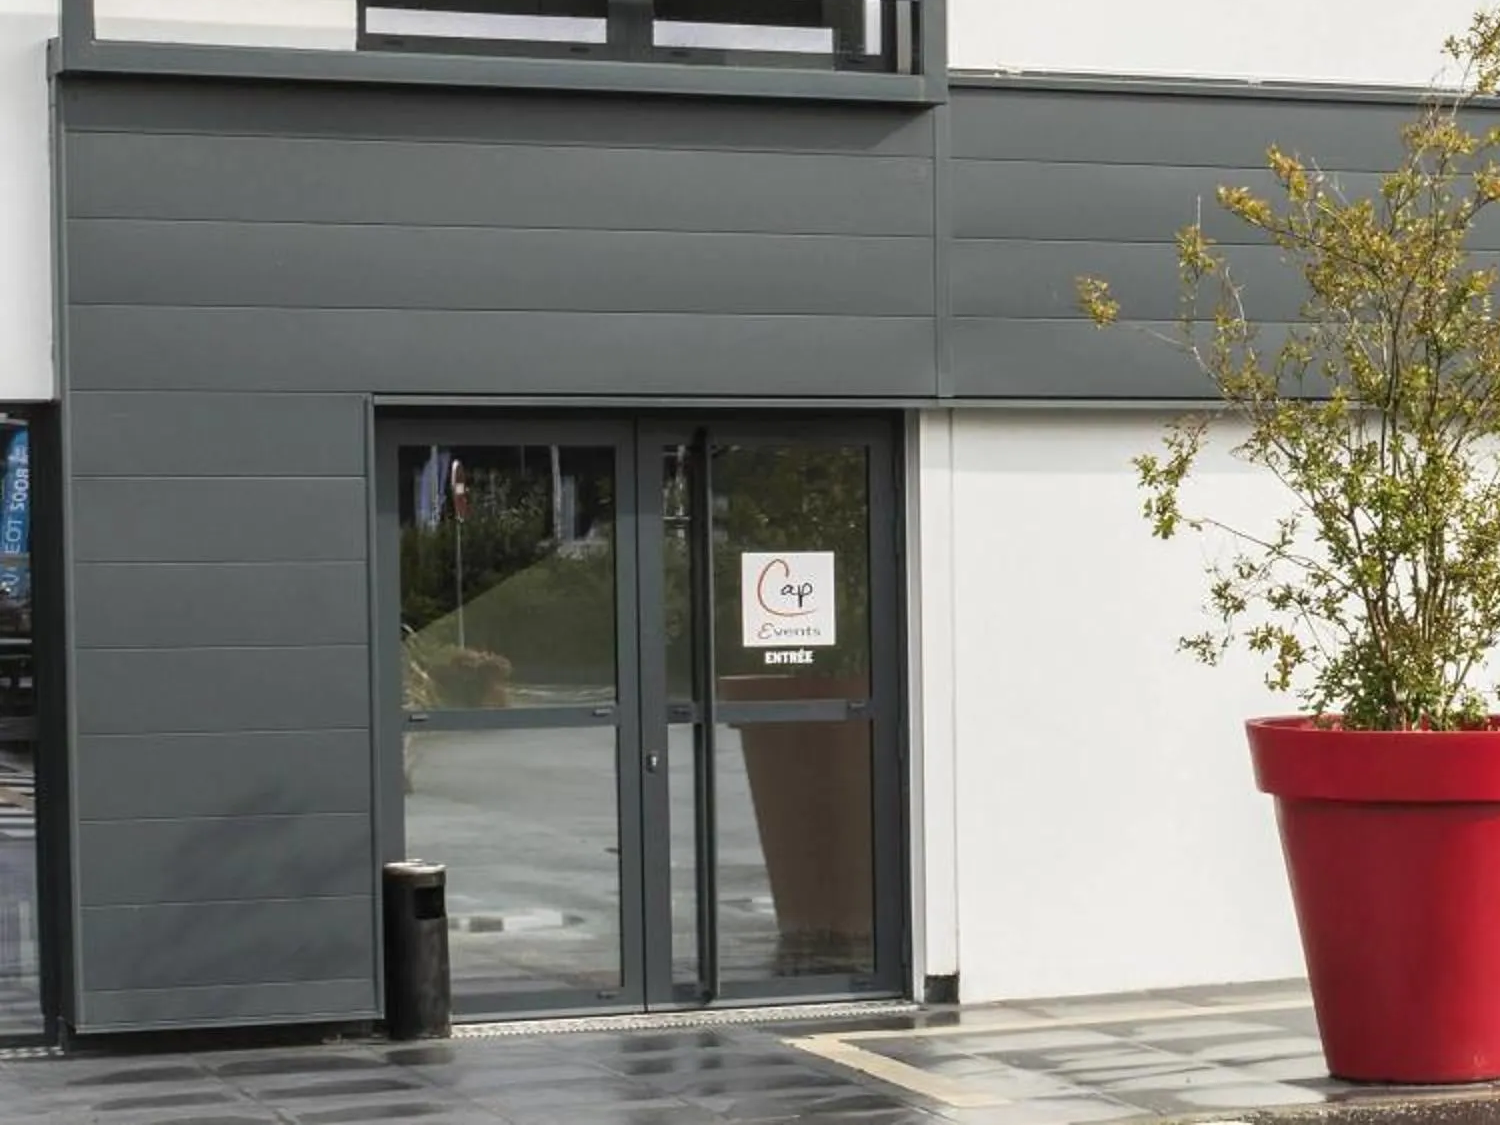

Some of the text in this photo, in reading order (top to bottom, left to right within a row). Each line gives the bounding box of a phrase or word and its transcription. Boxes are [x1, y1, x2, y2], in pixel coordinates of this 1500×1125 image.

[757, 558, 816, 617] Cap
[757, 622, 821, 640] Events
[764, 648, 814, 664] ENTRÉE
